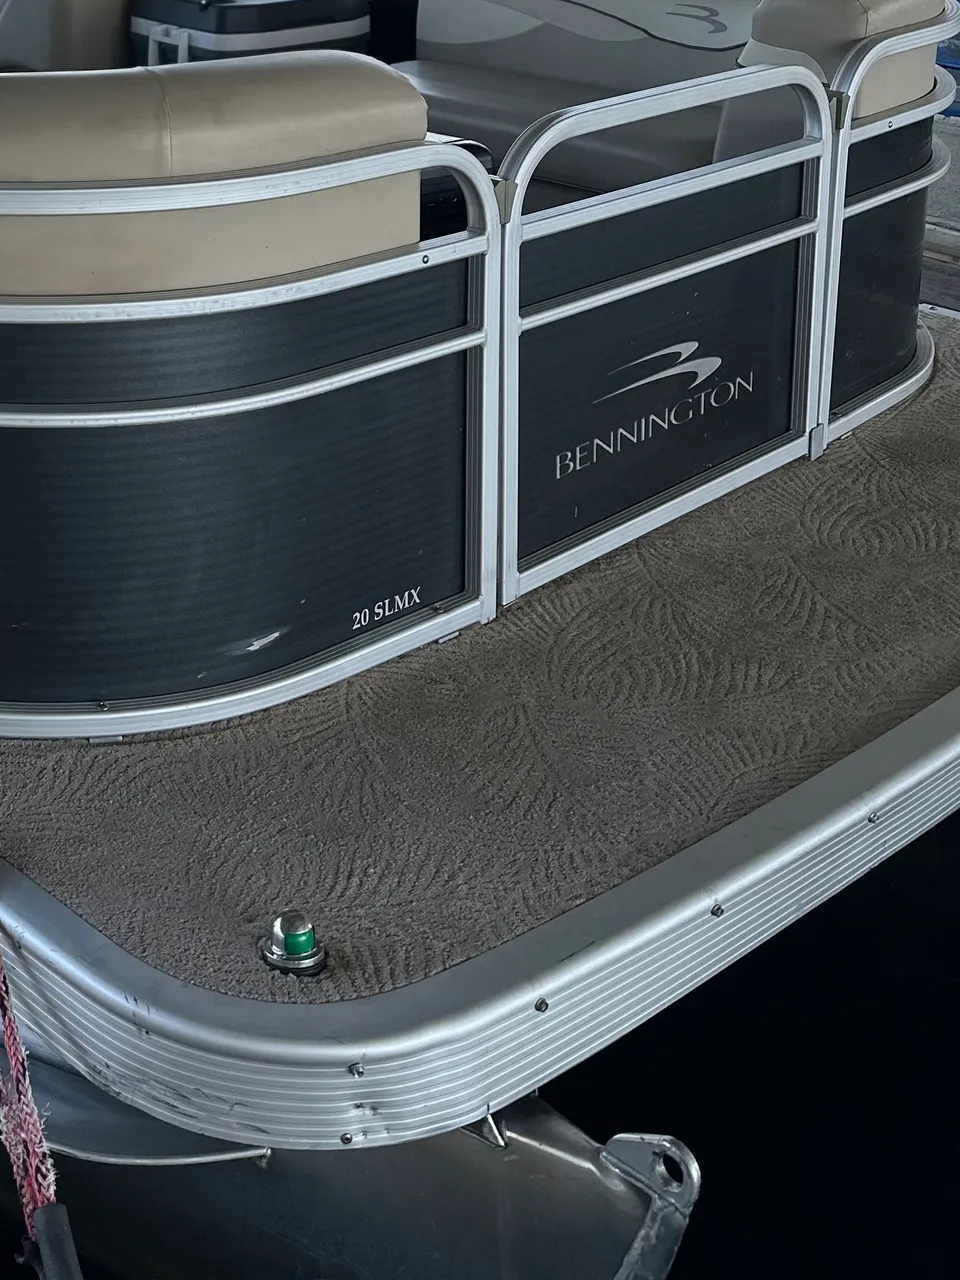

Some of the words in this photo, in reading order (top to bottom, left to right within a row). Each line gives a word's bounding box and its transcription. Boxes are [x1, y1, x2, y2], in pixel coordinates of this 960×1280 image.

[555, 371, 754, 480] BENNINGTON
[352, 608, 370, 630] 20
[374, 586, 421, 621] SLMX
